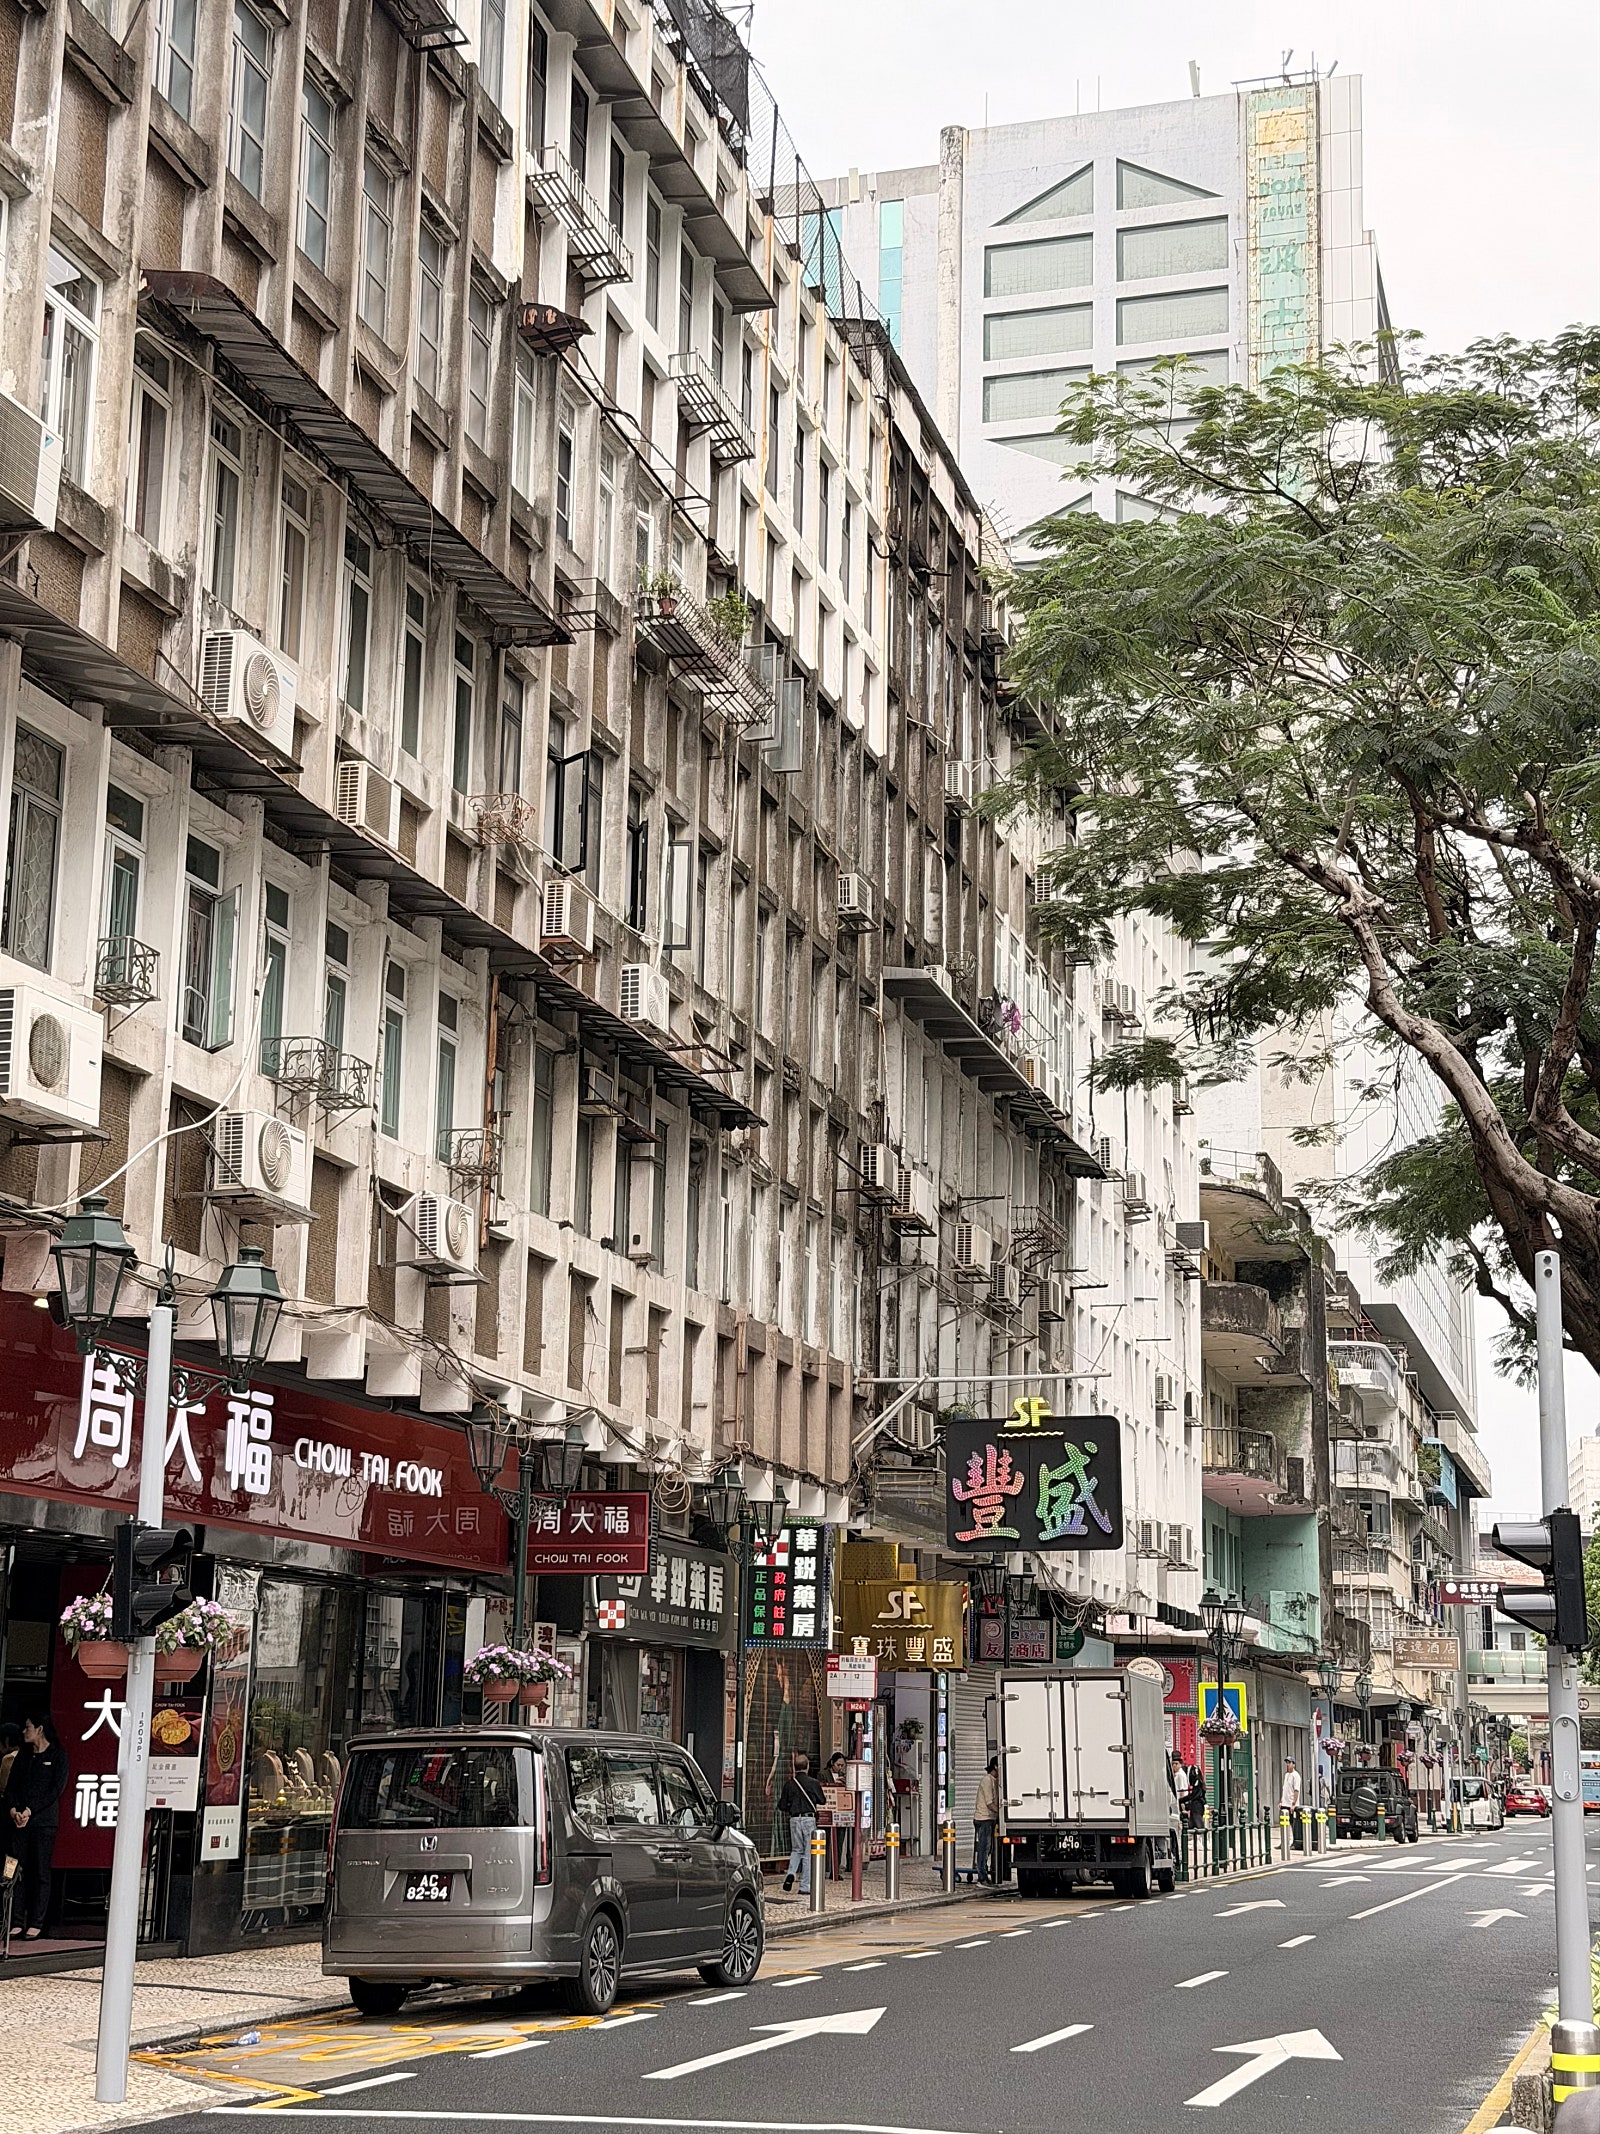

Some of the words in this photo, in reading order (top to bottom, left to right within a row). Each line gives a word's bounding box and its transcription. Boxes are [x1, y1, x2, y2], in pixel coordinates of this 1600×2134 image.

[74, 1355, 274, 1495] 周大福
[1004, 1396, 1053, 1428] SF
[294, 1437, 351, 1477] CHOW
[360, 1452, 390, 1486] TAI
[396, 1460, 443, 1498] FOOK
[952, 1441, 1114, 1543] 豐盛
[536, 1505, 630, 1535] 周大福
[534, 1553, 569, 1564] CHOW
[572, 1553, 591, 1563] TAI
[596, 1553, 629, 1563] FOOK
[878, 1591, 927, 1620] SF
[851, 1636, 954, 1663] 寶珠豐盛
[136, 1712, 144, 1762] 1503P3
[406, 1886, 448, 1901] 82-94
[420, 1874, 439, 1887] AC
